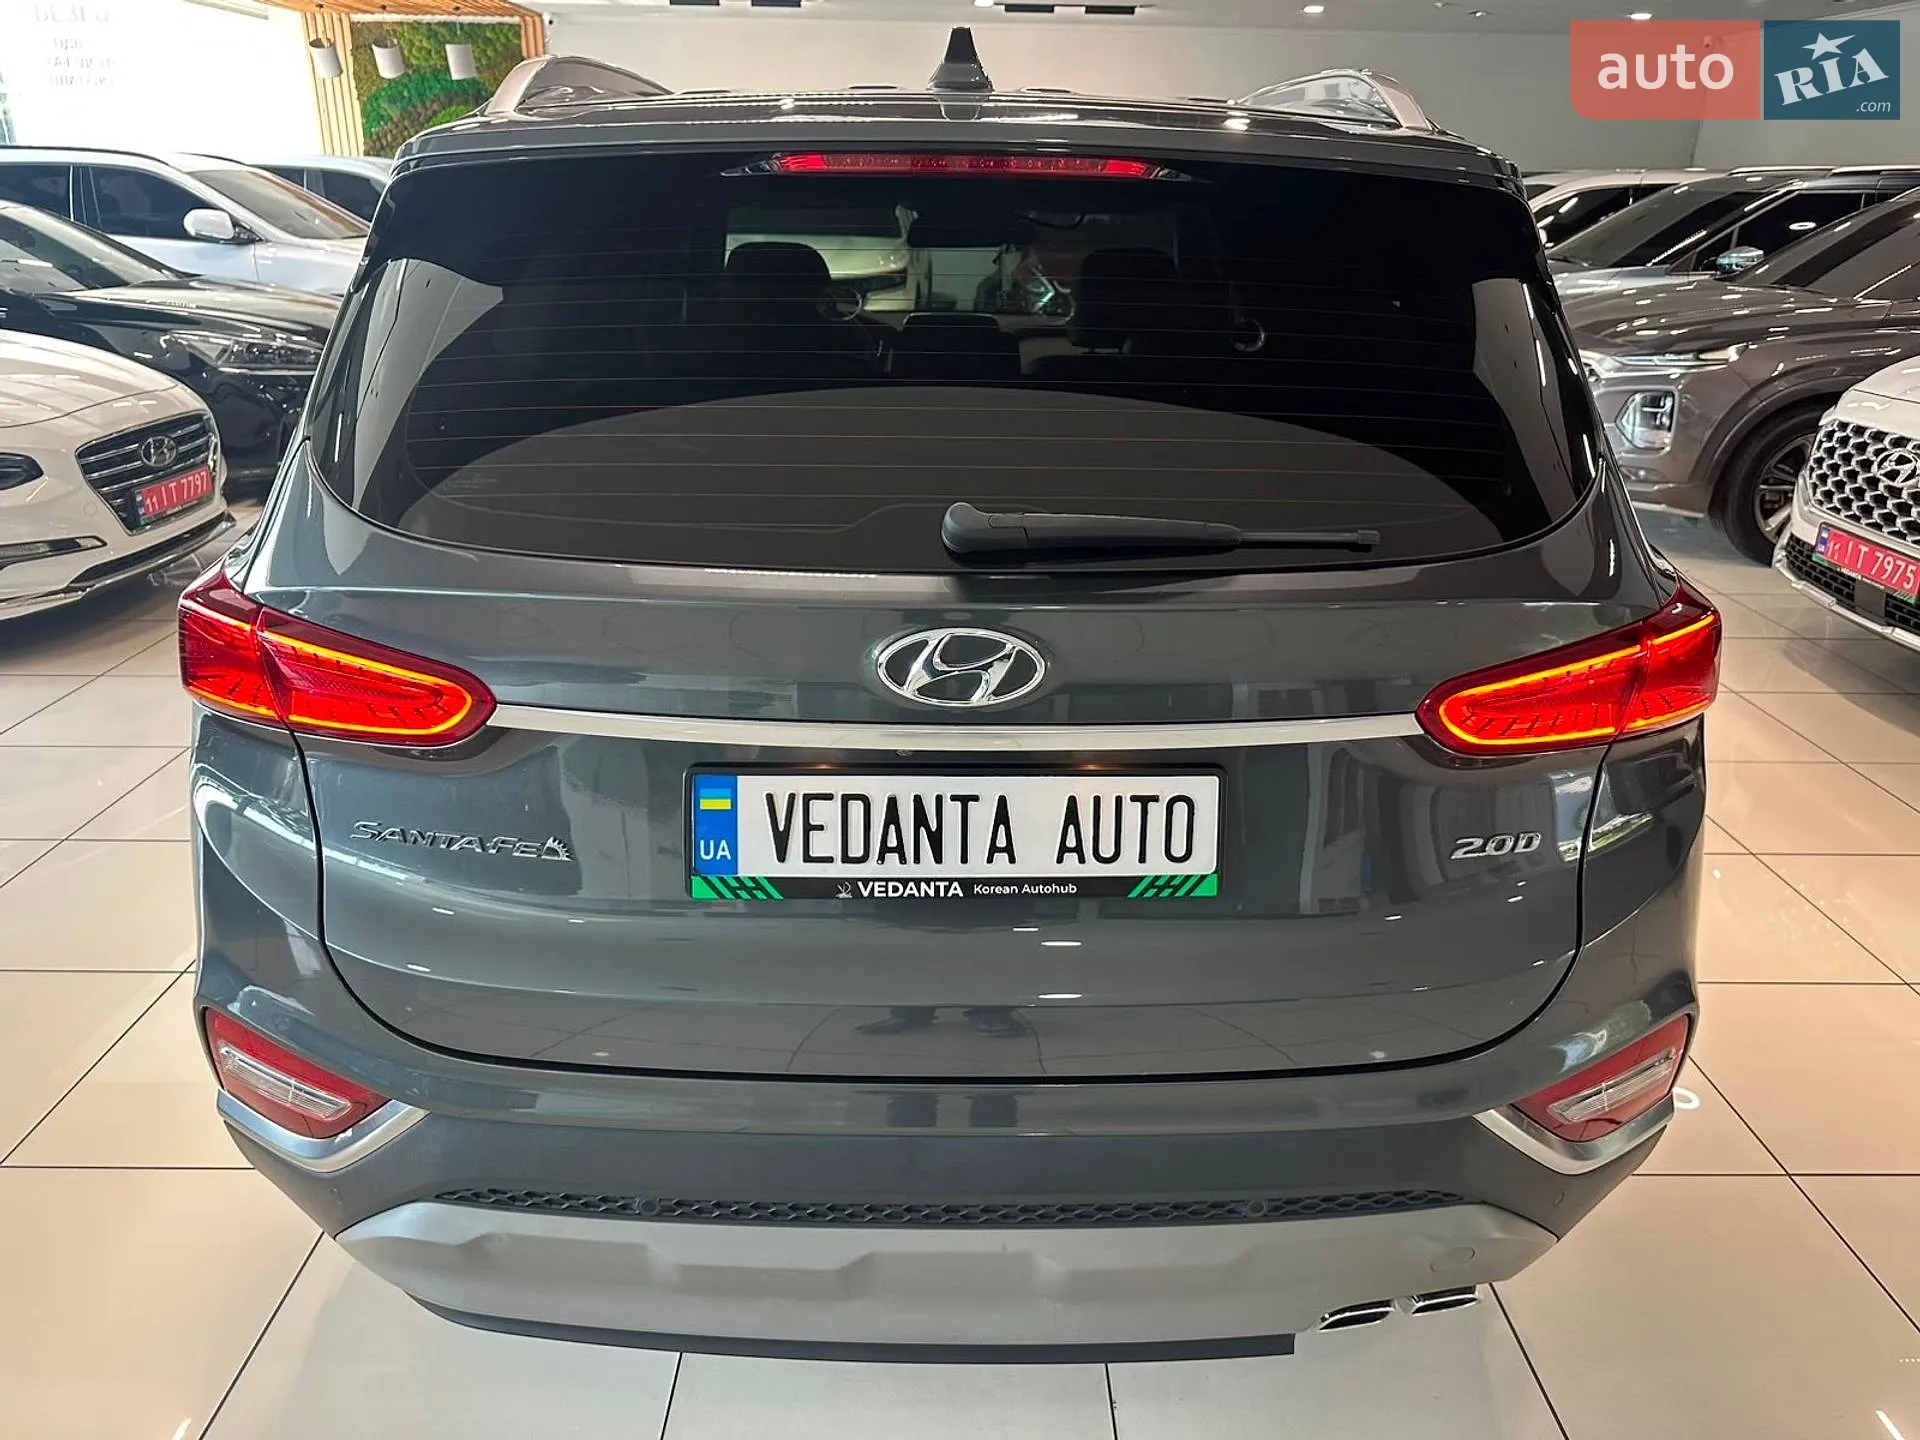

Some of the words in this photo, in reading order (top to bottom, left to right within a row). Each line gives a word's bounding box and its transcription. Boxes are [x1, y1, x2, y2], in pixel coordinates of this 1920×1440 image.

[181, 471, 207, 500] 7797
[1870, 551, 1918, 590] 7975
[764, 792, 1017, 865] VEDANTA
[1055, 794, 1196, 865] AUTO
[699, 839, 732, 861] UA
[856, 881, 964, 899] VEDANTA
[973, 883, 1019, 895] Korean
[1021, 882, 1078, 895] Autohub
